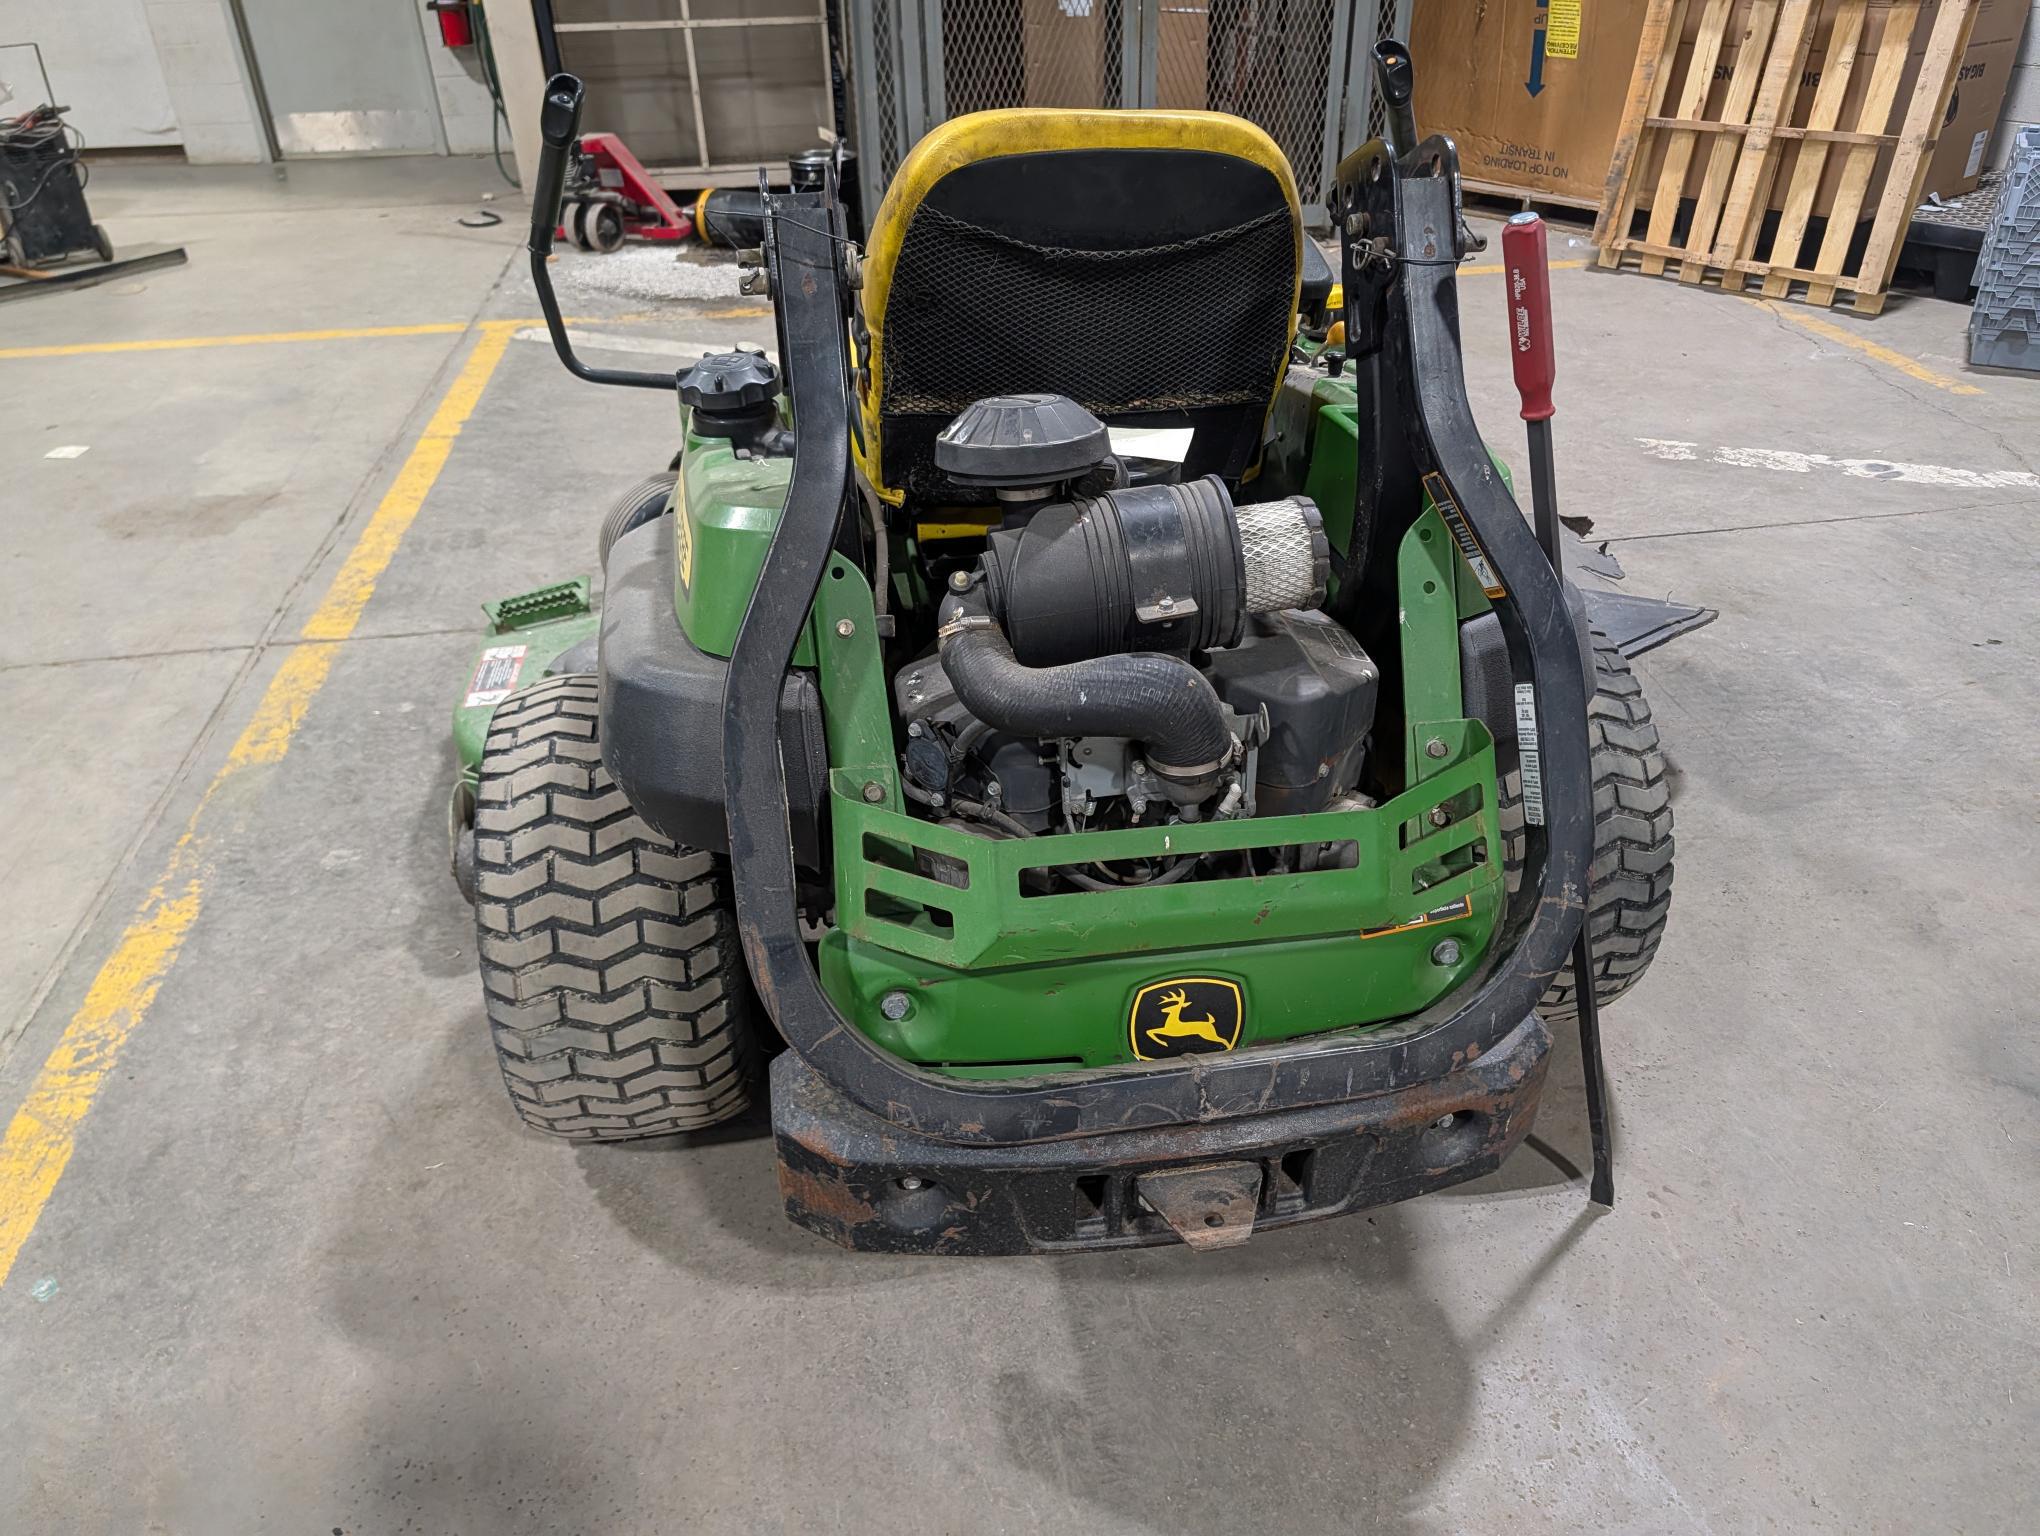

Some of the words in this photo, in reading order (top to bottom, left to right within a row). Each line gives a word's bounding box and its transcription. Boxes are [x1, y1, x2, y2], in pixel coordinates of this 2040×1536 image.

[1547, 41, 1578, 49] RECEIVING
[1499, 143, 1542, 160] TRANSIT
[1544, 150, 1556, 161] IN
[1483, 154, 1528, 173] LOADING
[1528, 163, 1551, 176] TOP
[1552, 166, 1569, 179] NO
